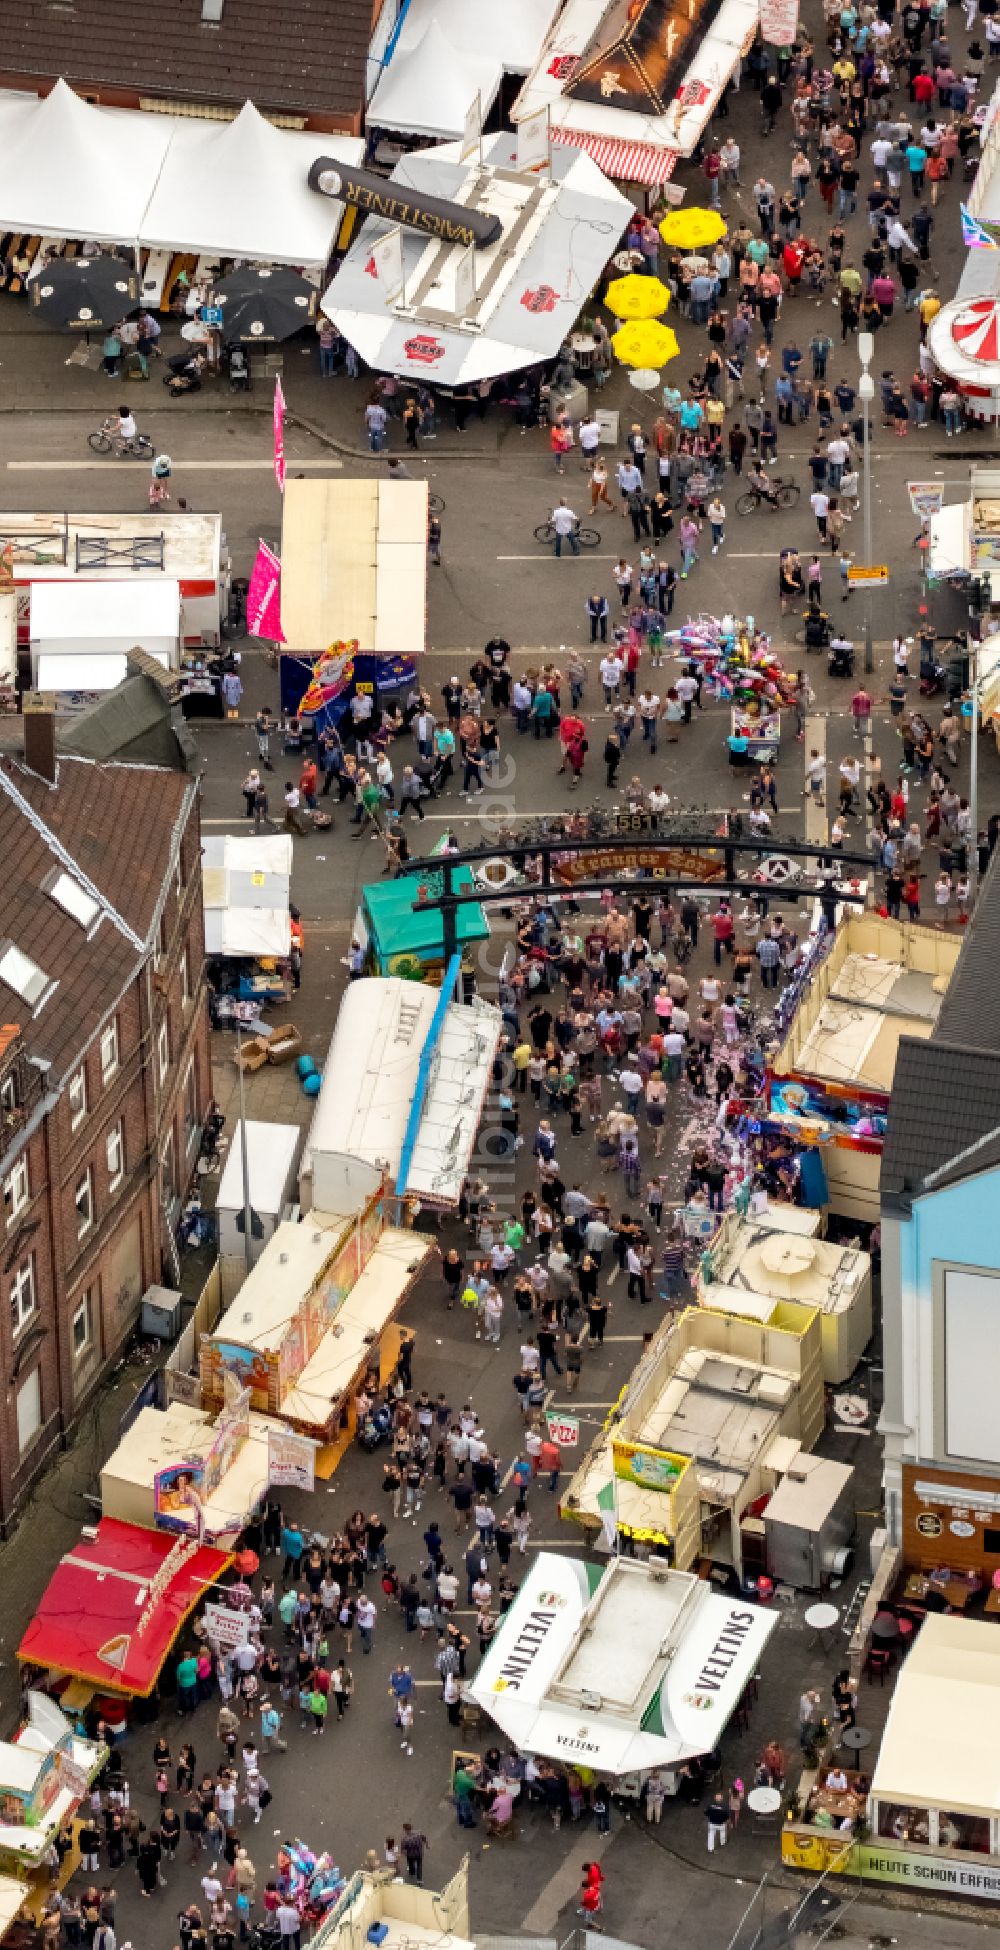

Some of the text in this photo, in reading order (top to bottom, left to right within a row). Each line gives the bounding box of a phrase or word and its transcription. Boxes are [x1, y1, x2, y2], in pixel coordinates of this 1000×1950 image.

[345, 181, 475, 247] WARSTEINER
[694, 1610, 755, 1692] VELTINS
[869, 1857, 911, 1876] HEUTE
[914, 1865, 957, 1884] SCHON
